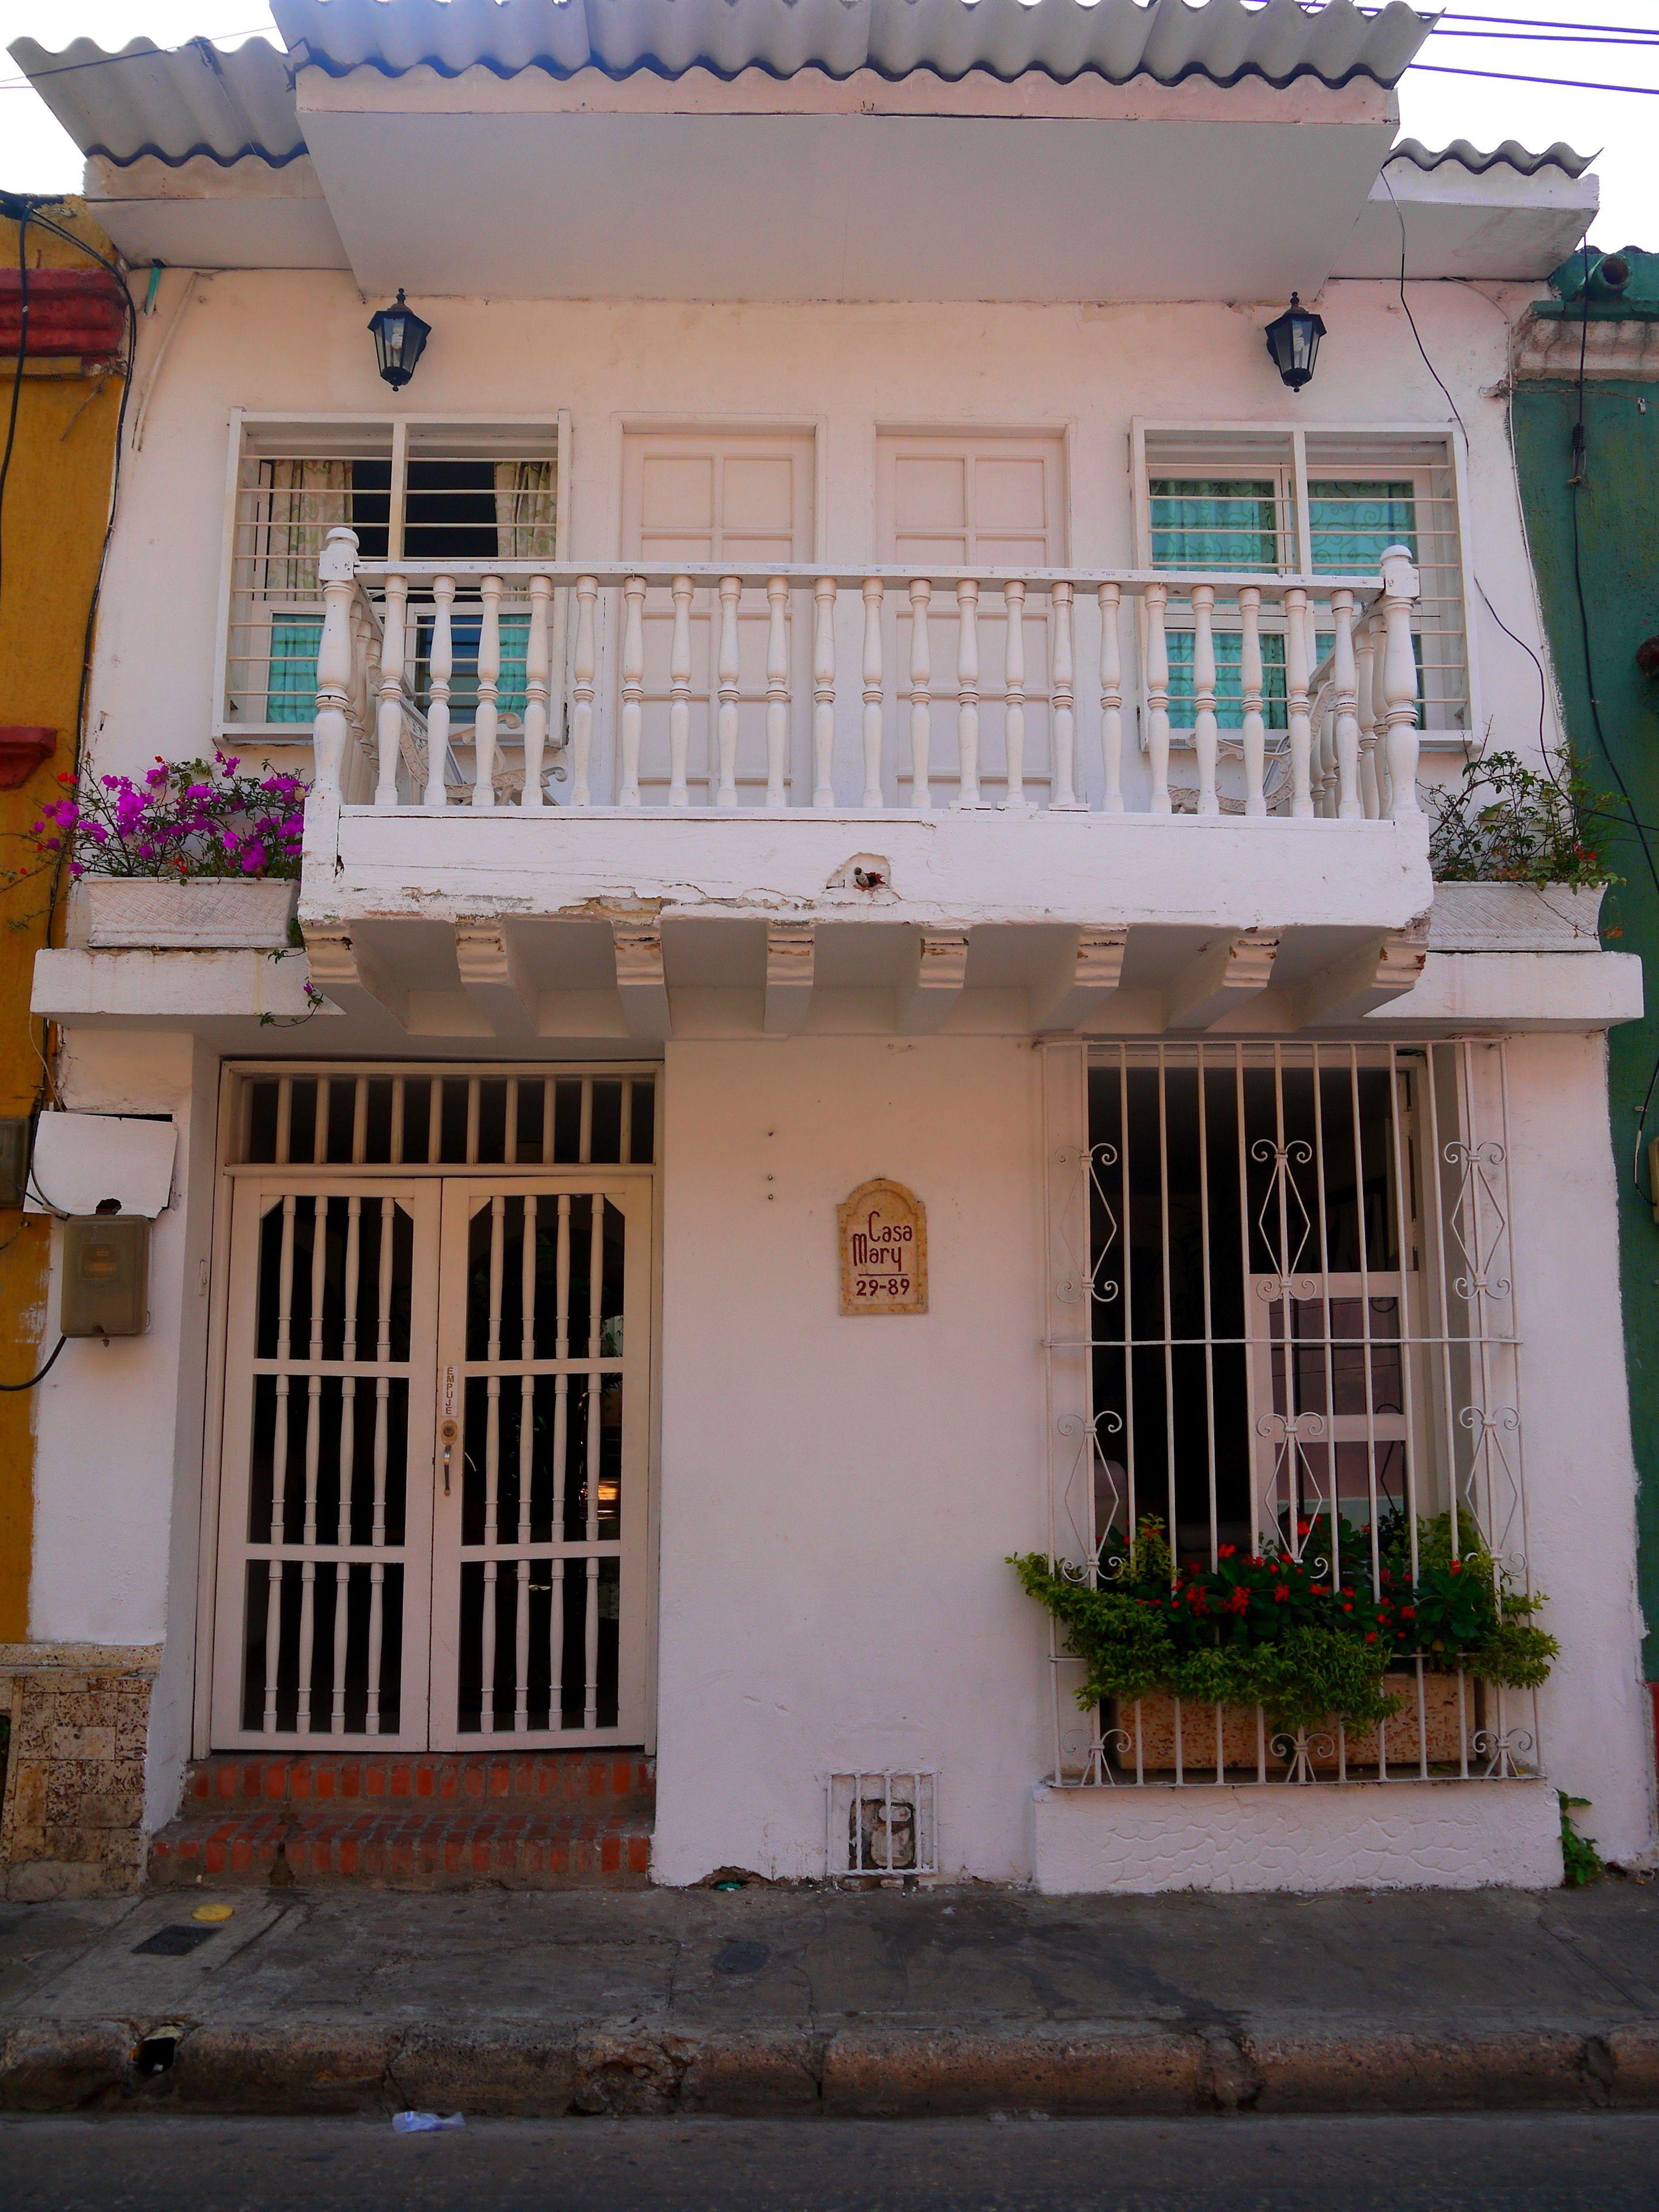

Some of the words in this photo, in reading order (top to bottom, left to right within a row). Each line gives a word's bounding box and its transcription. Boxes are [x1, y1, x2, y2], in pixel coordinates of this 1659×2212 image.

[869, 1210, 912, 1242] Casa
[853, 1233, 902, 1272] Mary
[856, 1278, 910, 1296] 29-89
[445, 1367, 454, 1415] EMPUJE
